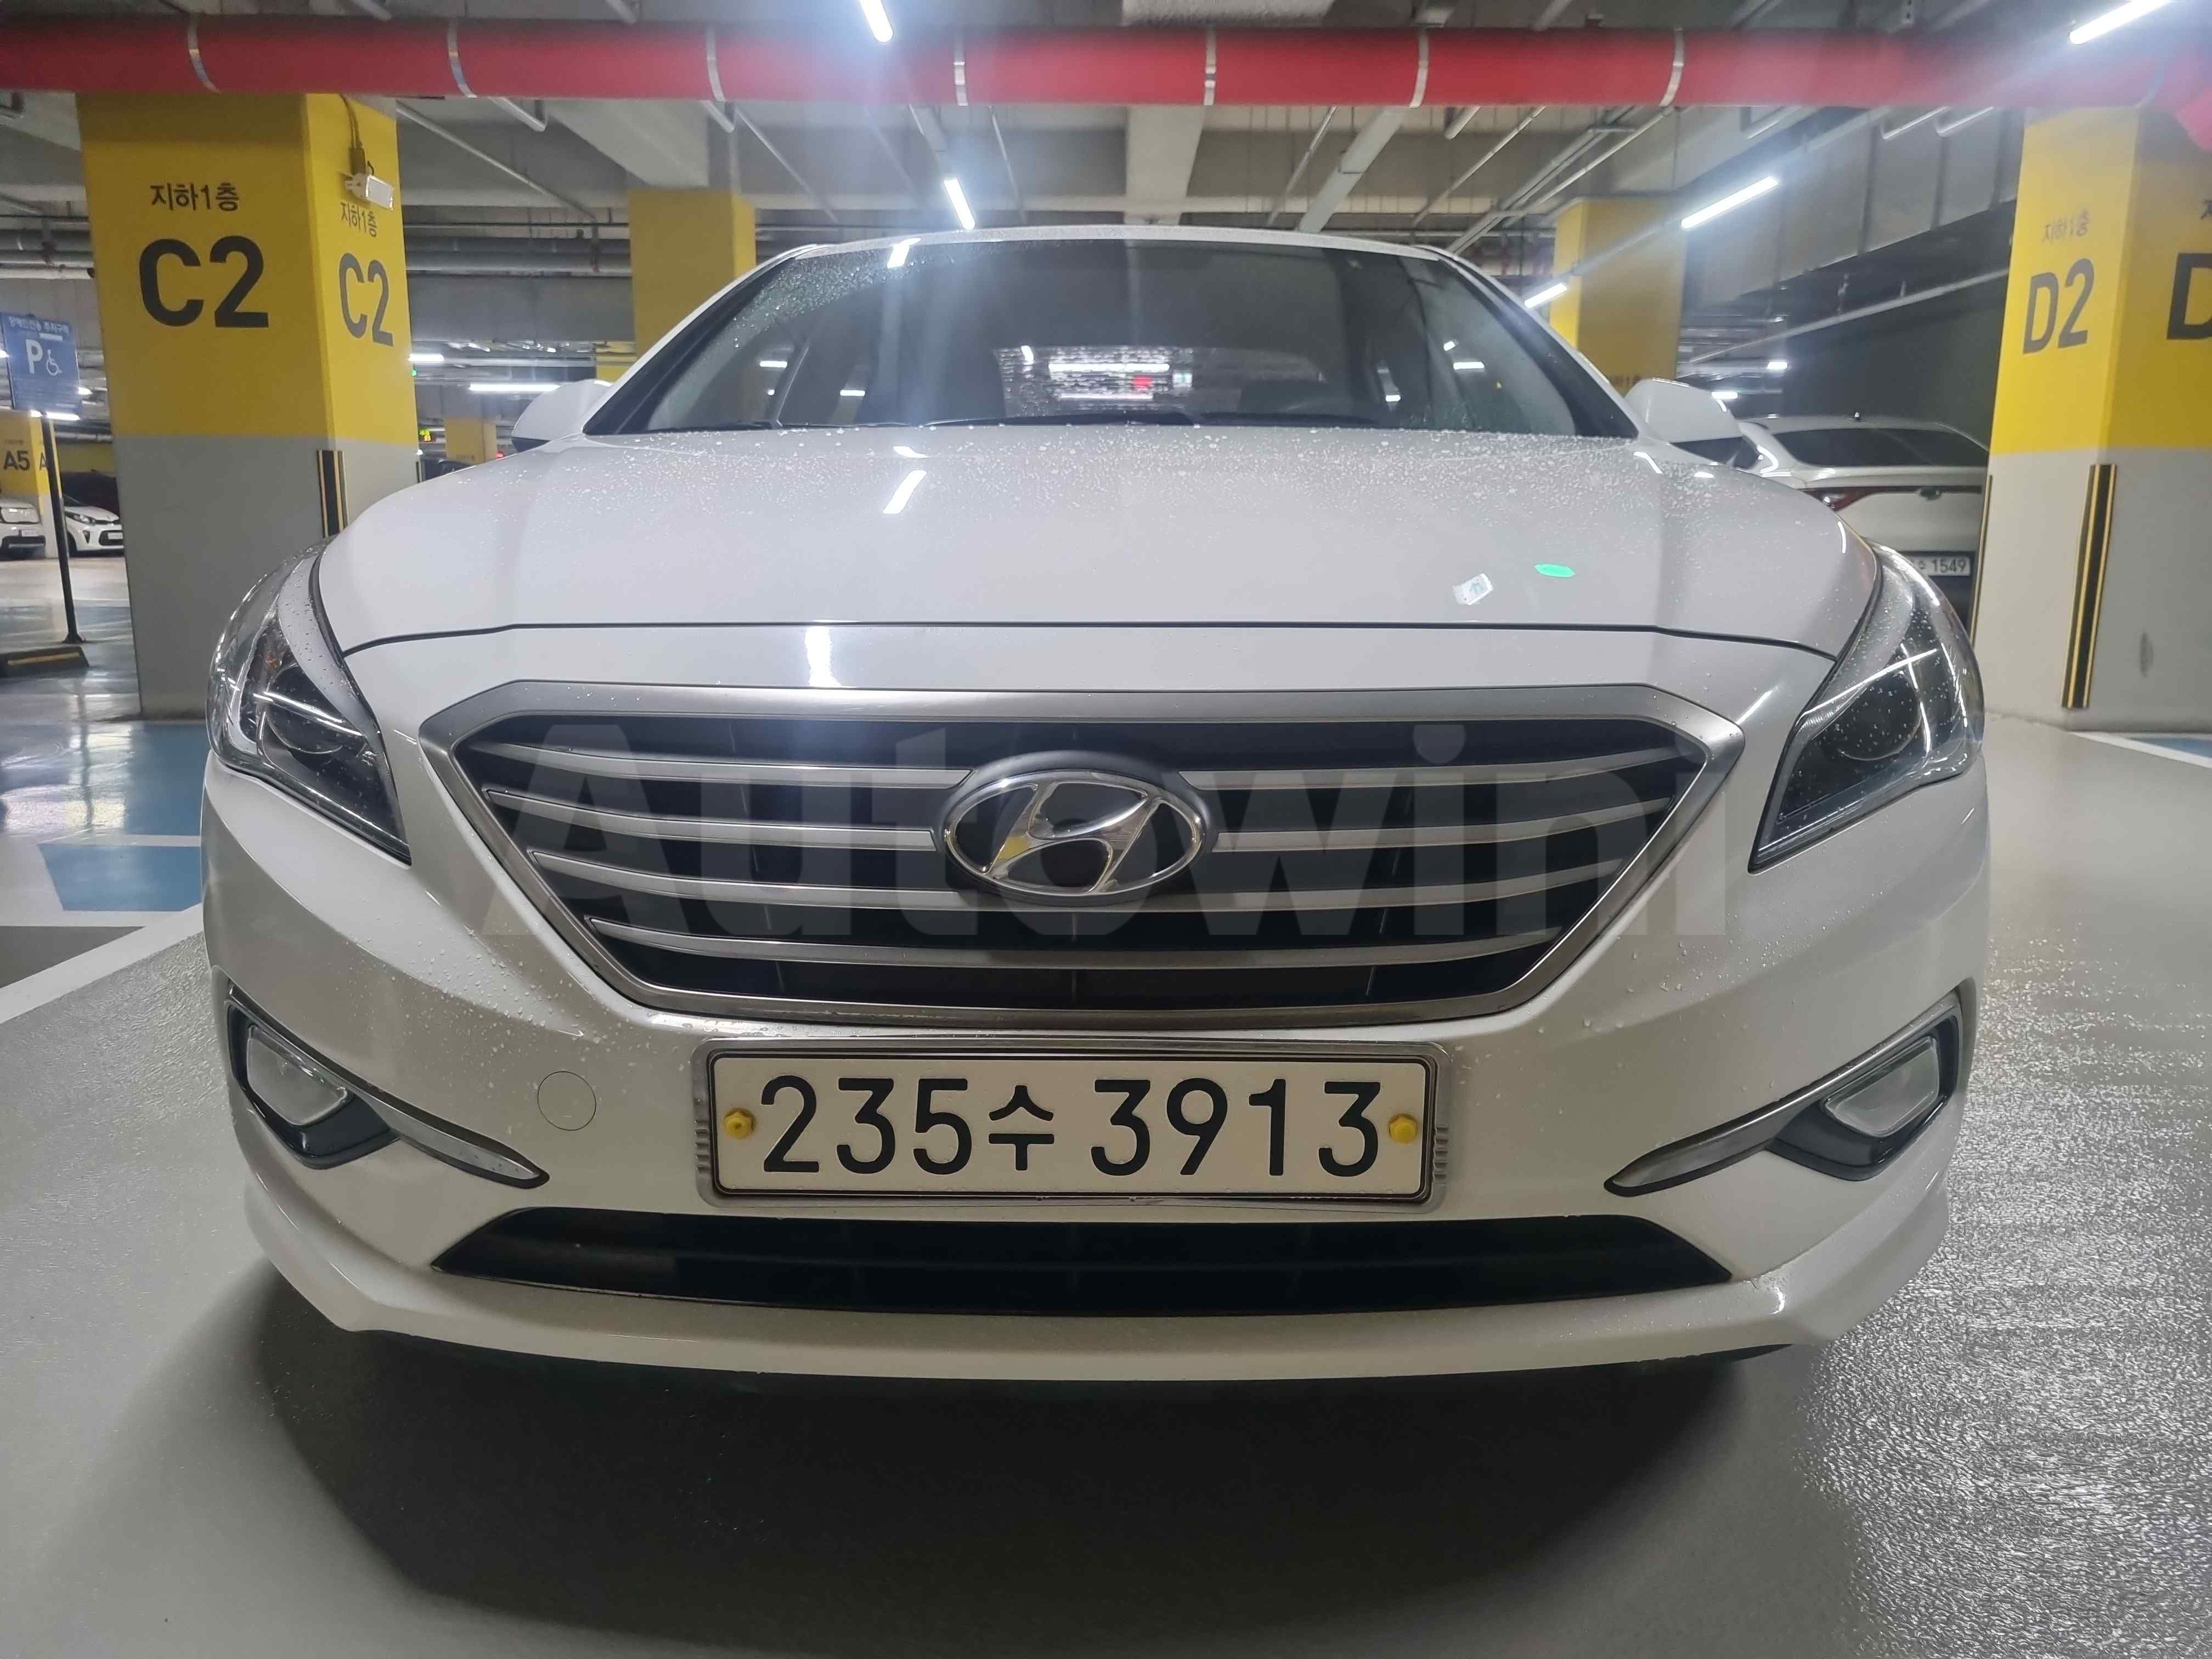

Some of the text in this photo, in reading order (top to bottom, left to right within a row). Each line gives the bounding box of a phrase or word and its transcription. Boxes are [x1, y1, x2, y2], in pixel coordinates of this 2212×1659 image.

[150, 183, 240, 212] 지하1층
[340, 201, 377, 238] 지하1층
[139, 235, 269, 328] C2
[338, 252, 394, 347] C2
[2023, 258, 2095, 354] D2
[25, 338, 44, 374] P
[3, 450, 31, 471] A5
[1931, 558, 1967, 573] 1549
[760, 1075, 1381, 1177] 235수 3913
